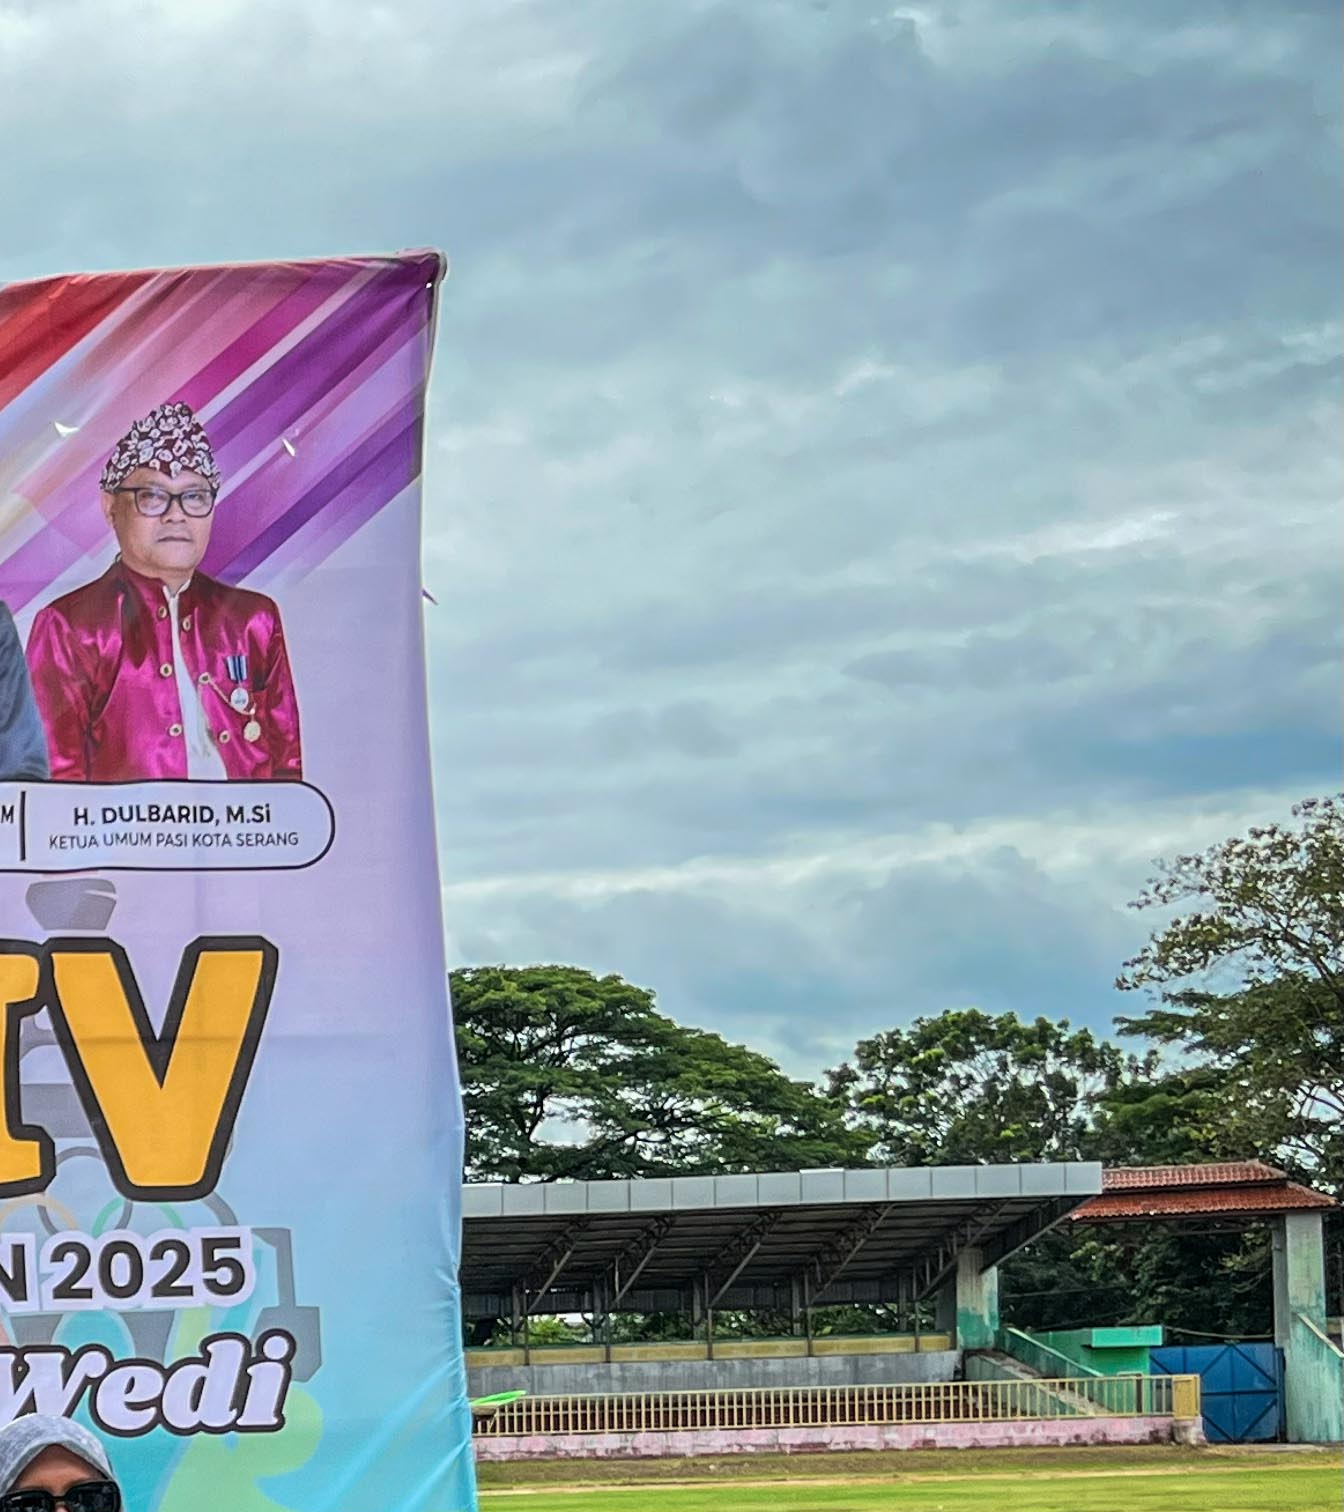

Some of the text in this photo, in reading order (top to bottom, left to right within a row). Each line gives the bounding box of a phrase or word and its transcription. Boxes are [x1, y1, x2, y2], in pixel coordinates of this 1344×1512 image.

[73, 803, 270, 828] H. DULBARID, M.Si
[48, 832, 300, 849] KETUA UMUM PASI KOTA SERANG
[49, 1236, 249, 1302] 2025
